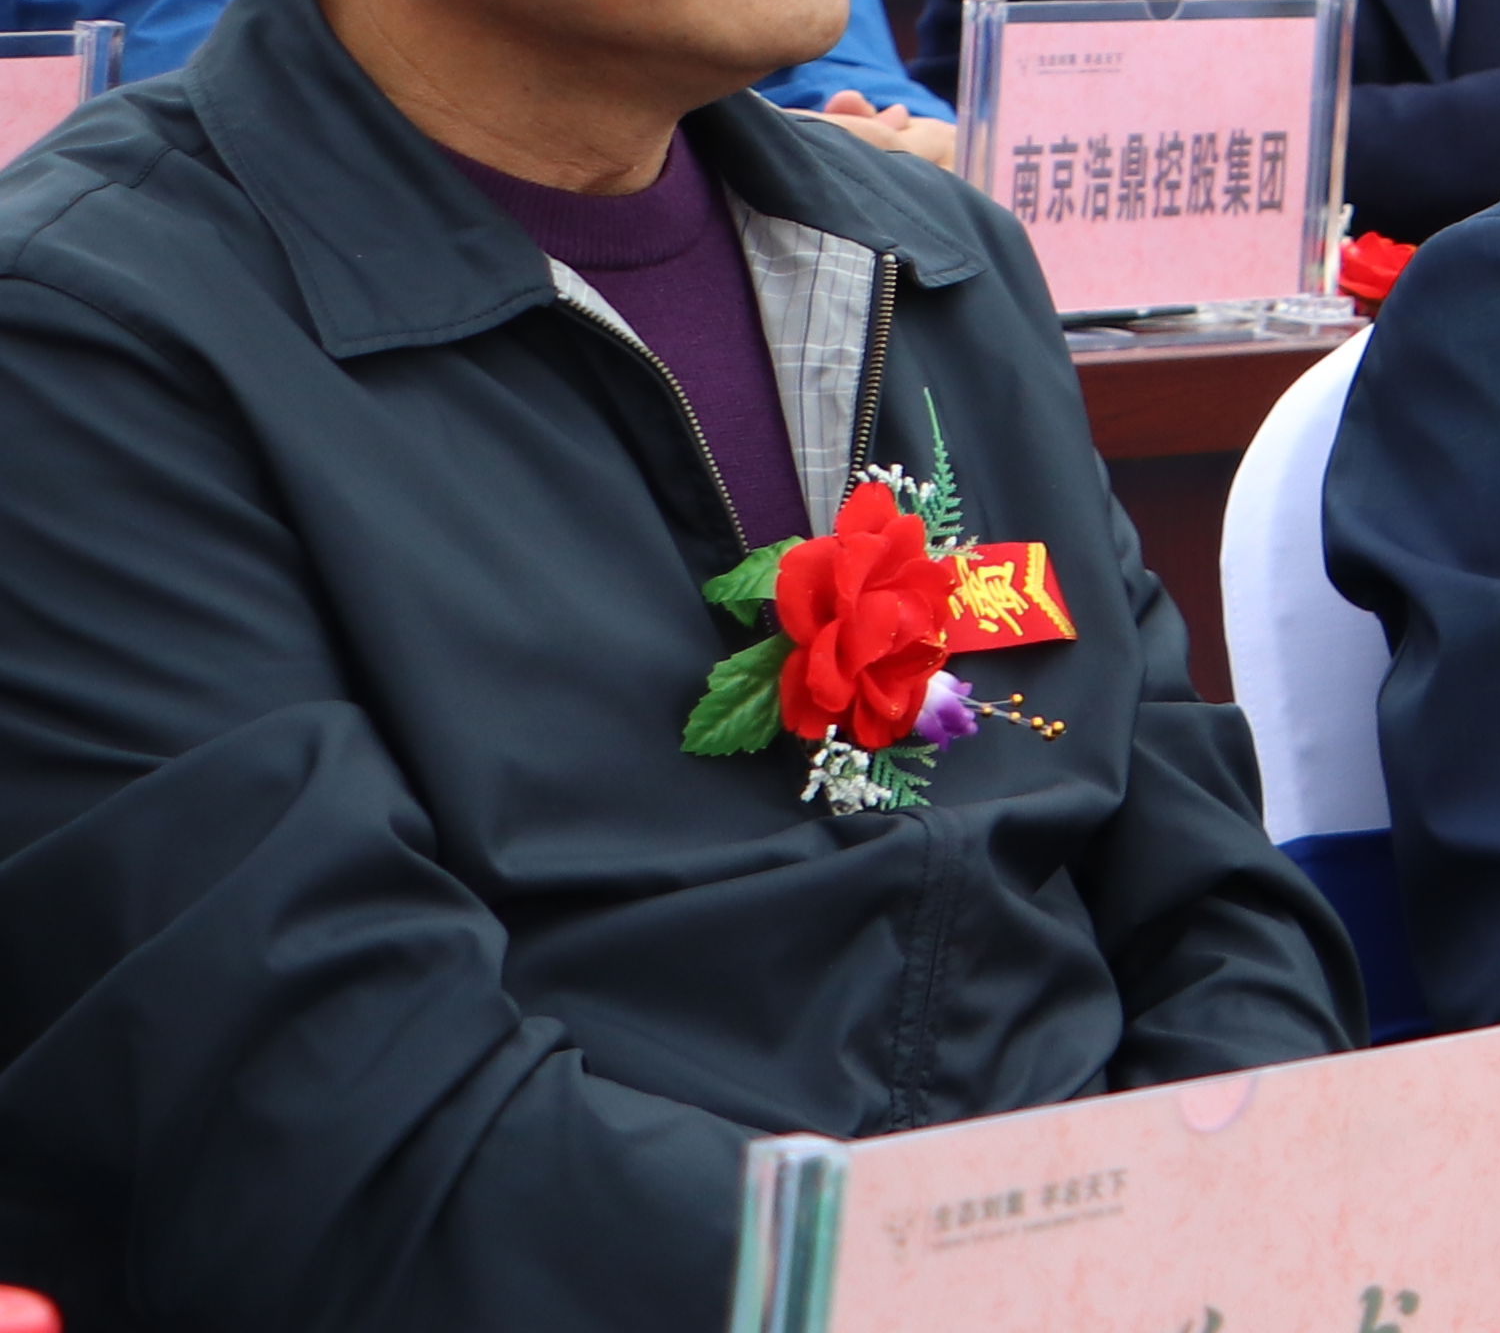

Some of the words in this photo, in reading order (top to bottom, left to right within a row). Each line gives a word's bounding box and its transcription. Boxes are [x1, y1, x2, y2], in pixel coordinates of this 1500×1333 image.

[1011, 128, 1289, 226] 南京浩鼎控股集团
